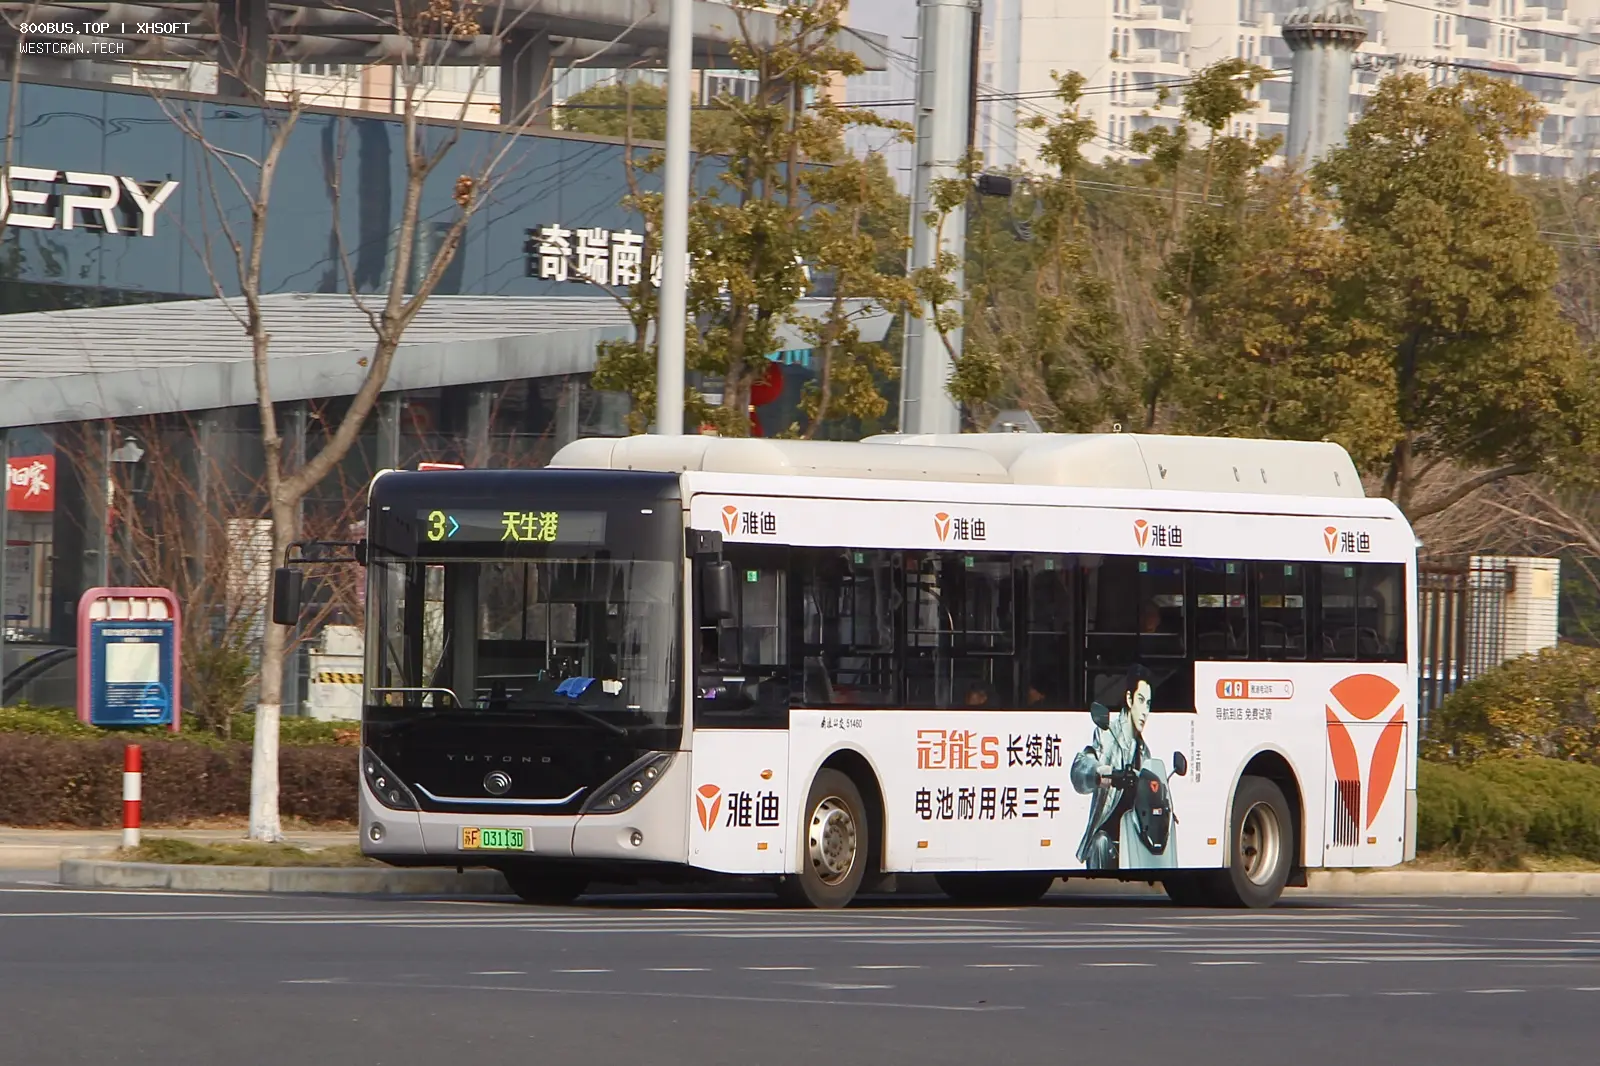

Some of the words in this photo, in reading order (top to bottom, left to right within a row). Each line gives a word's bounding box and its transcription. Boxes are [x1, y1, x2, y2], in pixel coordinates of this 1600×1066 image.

[427, 510, 446, 541] 3
[500, 511, 559, 542] 天生港
[742, 510, 776, 535] 雅迪
[953, 518, 987, 541] 雅迪
[1151, 525, 1183, 548] 雅迪
[1340, 531, 1371, 554] 雅迪
[447, 754, 552, 763] YUTONG
[1007, 734, 1063, 768] 长续航
[726, 790, 780, 828] 雅迪
[915, 785, 1061, 821] 电池耐用保三年
